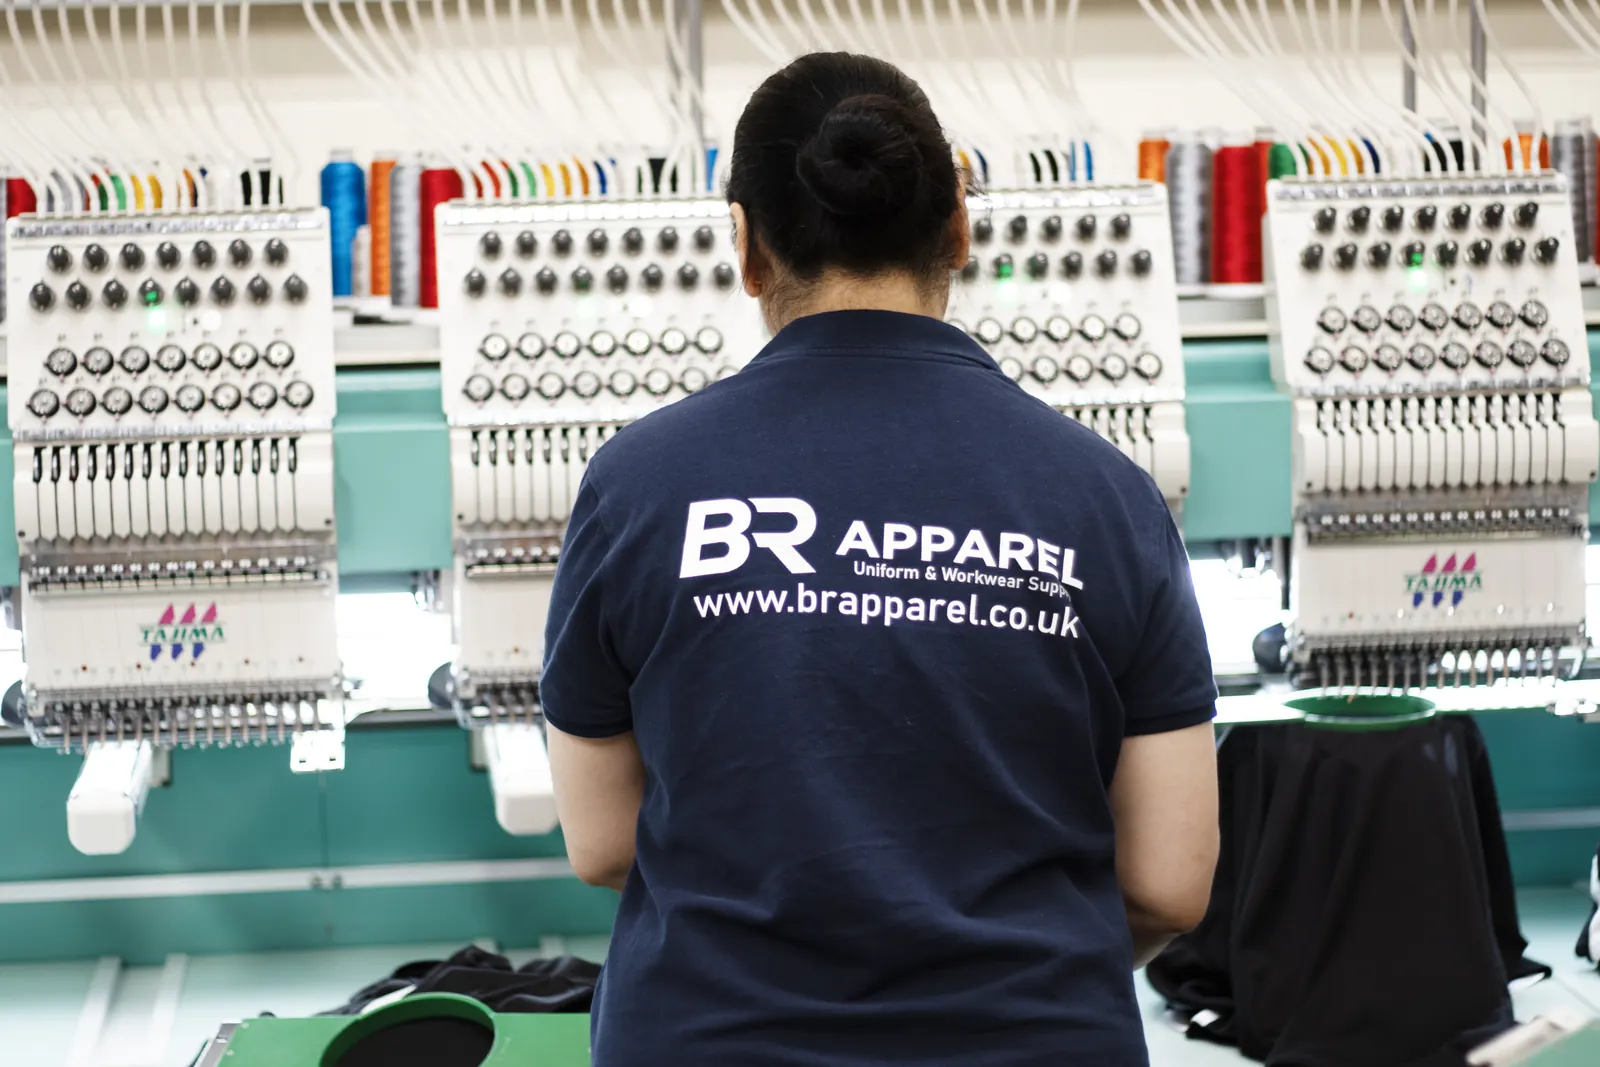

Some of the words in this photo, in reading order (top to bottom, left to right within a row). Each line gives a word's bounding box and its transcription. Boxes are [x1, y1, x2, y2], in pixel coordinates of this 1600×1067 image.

[679, 497, 817, 579] BR
[835, 520, 1084, 591] APPAREL
[853, 560, 919, 580] Uniform
[924, 566, 937, 581] &
[941, 567, 1024, 589] Workwear
[693, 582, 1079, 639] www.brapparel.co.uk
